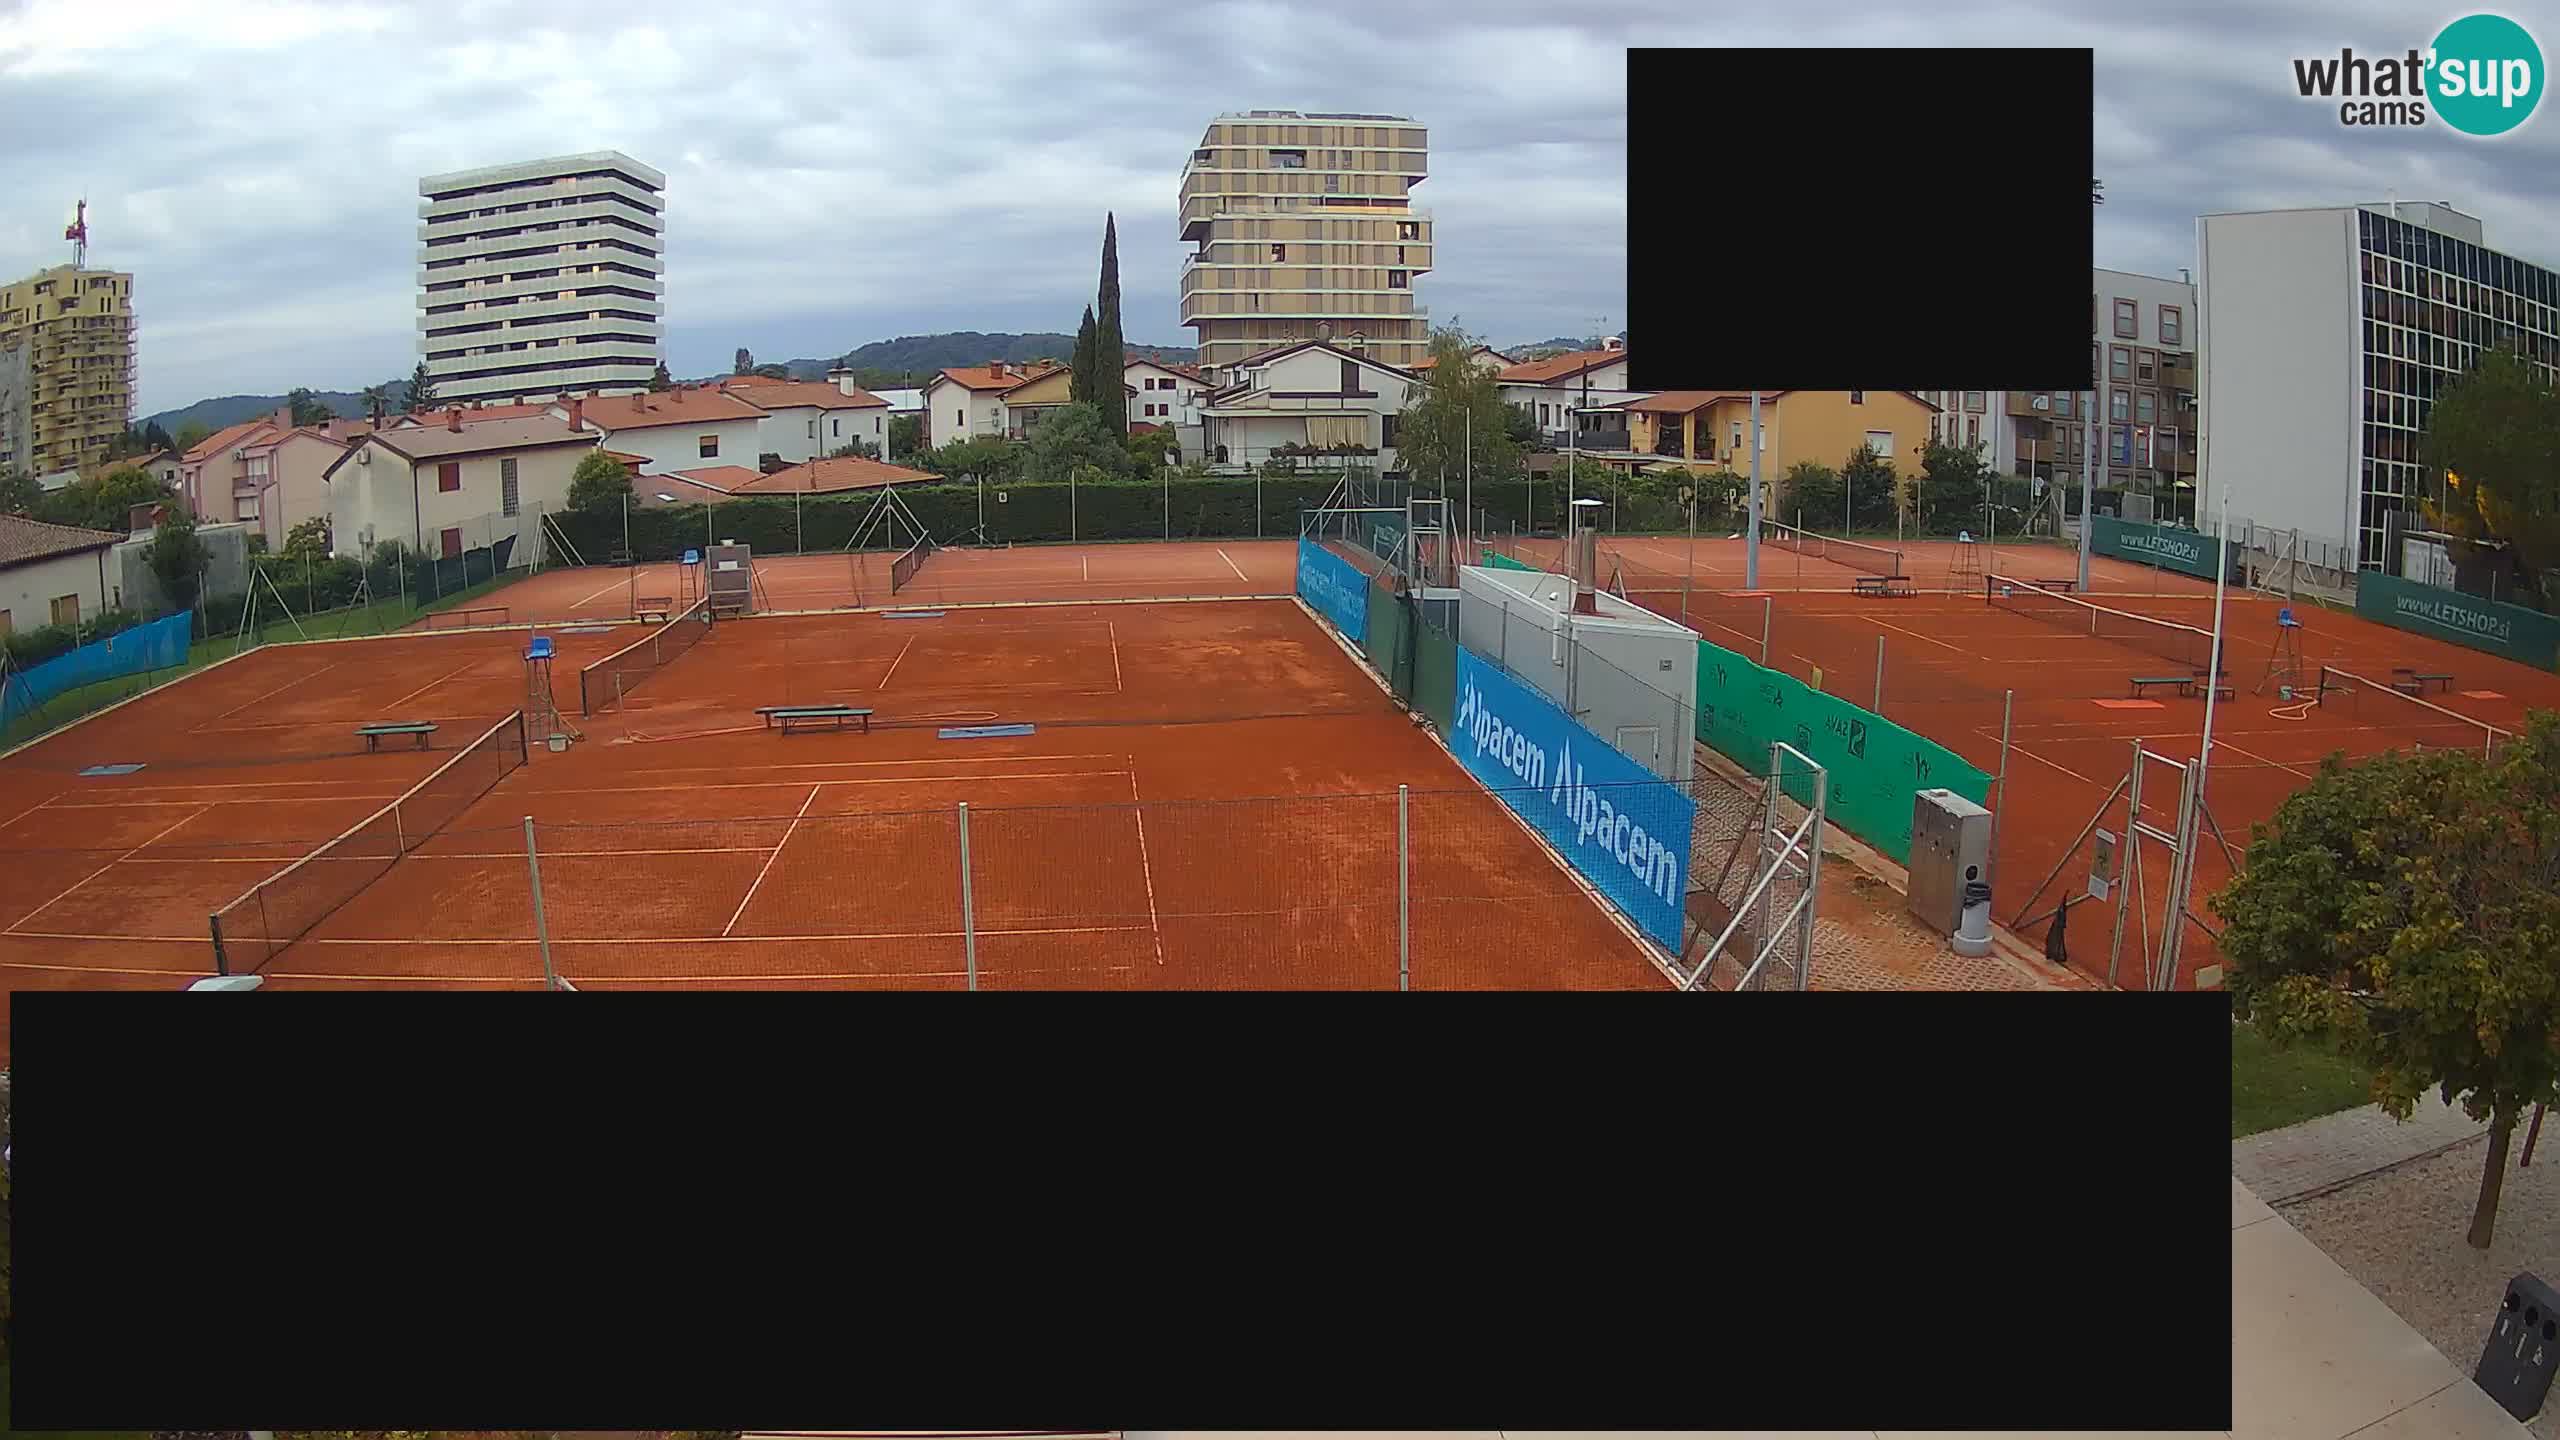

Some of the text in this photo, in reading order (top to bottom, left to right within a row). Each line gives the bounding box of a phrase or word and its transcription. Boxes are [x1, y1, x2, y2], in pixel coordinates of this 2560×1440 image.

[2121, 534, 2200, 560] www.LETSHOP.si
[2397, 595, 2511, 639] www.LETSHOP.si
[1457, 671, 1546, 792] Alpacem
[1552, 736, 1678, 907] Alpacem
